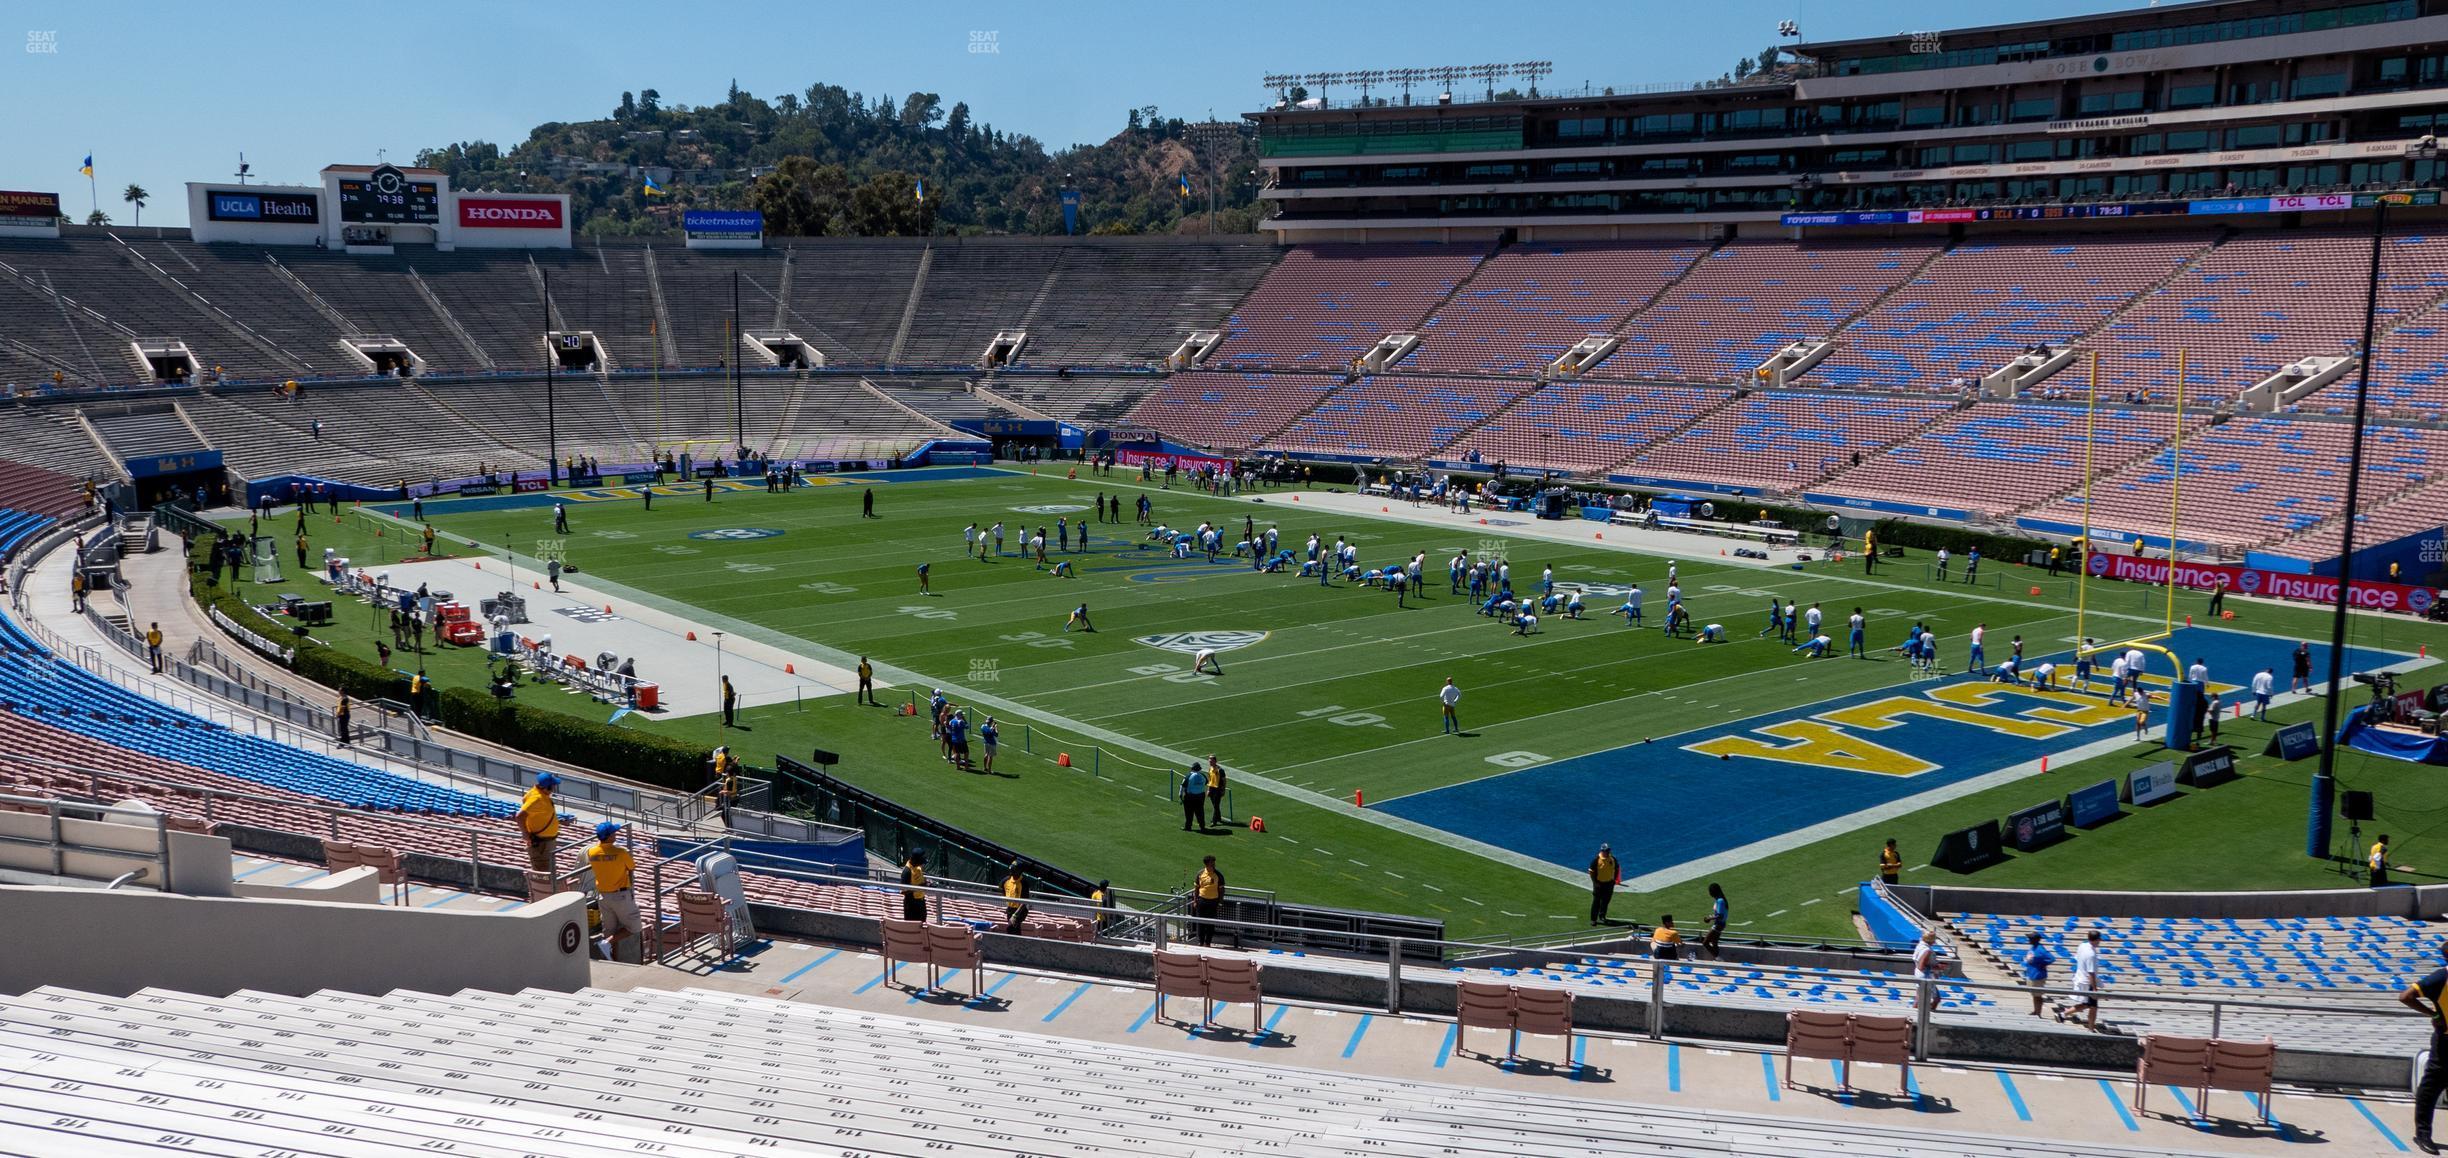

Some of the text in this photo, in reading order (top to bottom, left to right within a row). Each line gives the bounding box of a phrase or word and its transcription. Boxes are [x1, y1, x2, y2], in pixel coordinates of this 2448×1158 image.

[2047, 54, 2160, 75] ROSE BOWL
[11, 196, 56, 206] MANUEL
[2278, 198, 2304, 208] TCL
[2317, 196, 2344, 206] TCL
[221, 201, 312, 216] UCLA Health
[2100, 206, 2122, 216] 79:38
[467, 208, 554, 220] HONDA
[687, 216, 756, 226] ticketmaster
[1786, 216, 1810, 224] TOYO
[563, 336, 580, 348] 40
[1110, 431, 1156, 440] HONDA
[519, 480, 544, 490] TCL
[462, 486, 496, 495] NISSAN
[2116, 557, 2230, 588] Insurance
[1000, 631, 1062, 648] 30
[1296, 705, 1386, 726] 10
[1484, 751, 1552, 768] G
[2135, 778, 2150, 792] UCLA
[1252, 818, 1260, 832] G
[566, 929, 576, 946] 8
[31, 1053, 59, 1062] 111
[188, 1052, 216, 1060] 107
[116, 1069, 146, 1078] 112
[444, 1072, 470, 1080] 109
[50, 1082, 84, 1091] 113
[195, 1080, 225, 1090] 113
[277, 1091, 306, 1101] 114
[415, 1087, 444, 1096] 110
[136, 1096, 170, 1105] 114
[489, 1097, 518, 1106] 111
[365, 1105, 396, 1114] 115
[671, 1105, 698, 1113] 112
[231, 1110, 266, 1121] 115
[573, 1112, 603, 1121] 112
[51, 1118, 91, 1129] 115
[453, 1118, 485, 1127] 116
[753, 1117, 781, 1125] 113
[321, 1125, 357, 1135] 116
[532, 1128, 565, 1138] 117
[664, 1125, 693, 1135] 113
[835, 1129, 863, 1137] 114
[157, 1135, 196, 1146] 116
[421, 1140, 456, 1150] 117
[749, 1138, 779, 1147] 114
[634, 1143, 667, 1151] 118
[925, 1142, 955, 1150] 115
